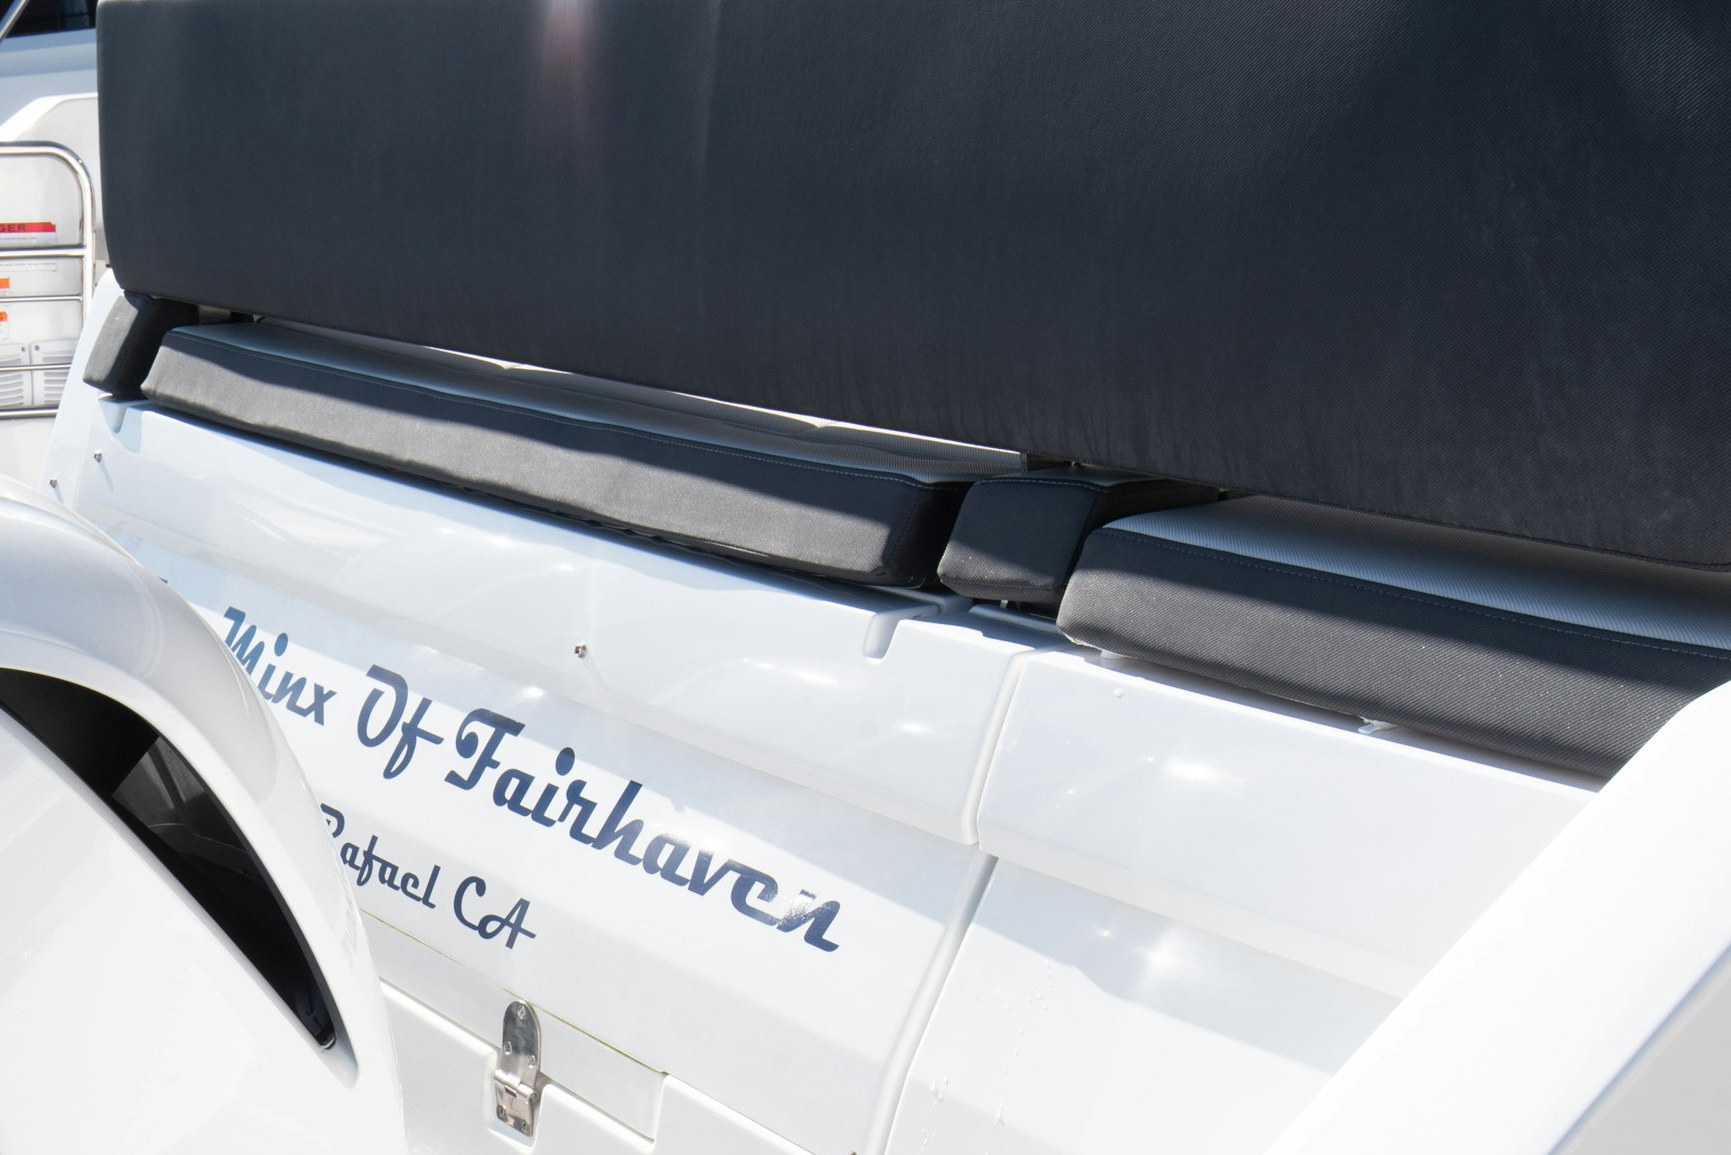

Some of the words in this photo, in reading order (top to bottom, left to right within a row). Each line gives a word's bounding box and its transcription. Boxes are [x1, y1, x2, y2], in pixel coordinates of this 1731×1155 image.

[356, 663, 445, 780] Of
[443, 708, 841, 953] Fairhaven
[453, 875, 537, 950] CA
